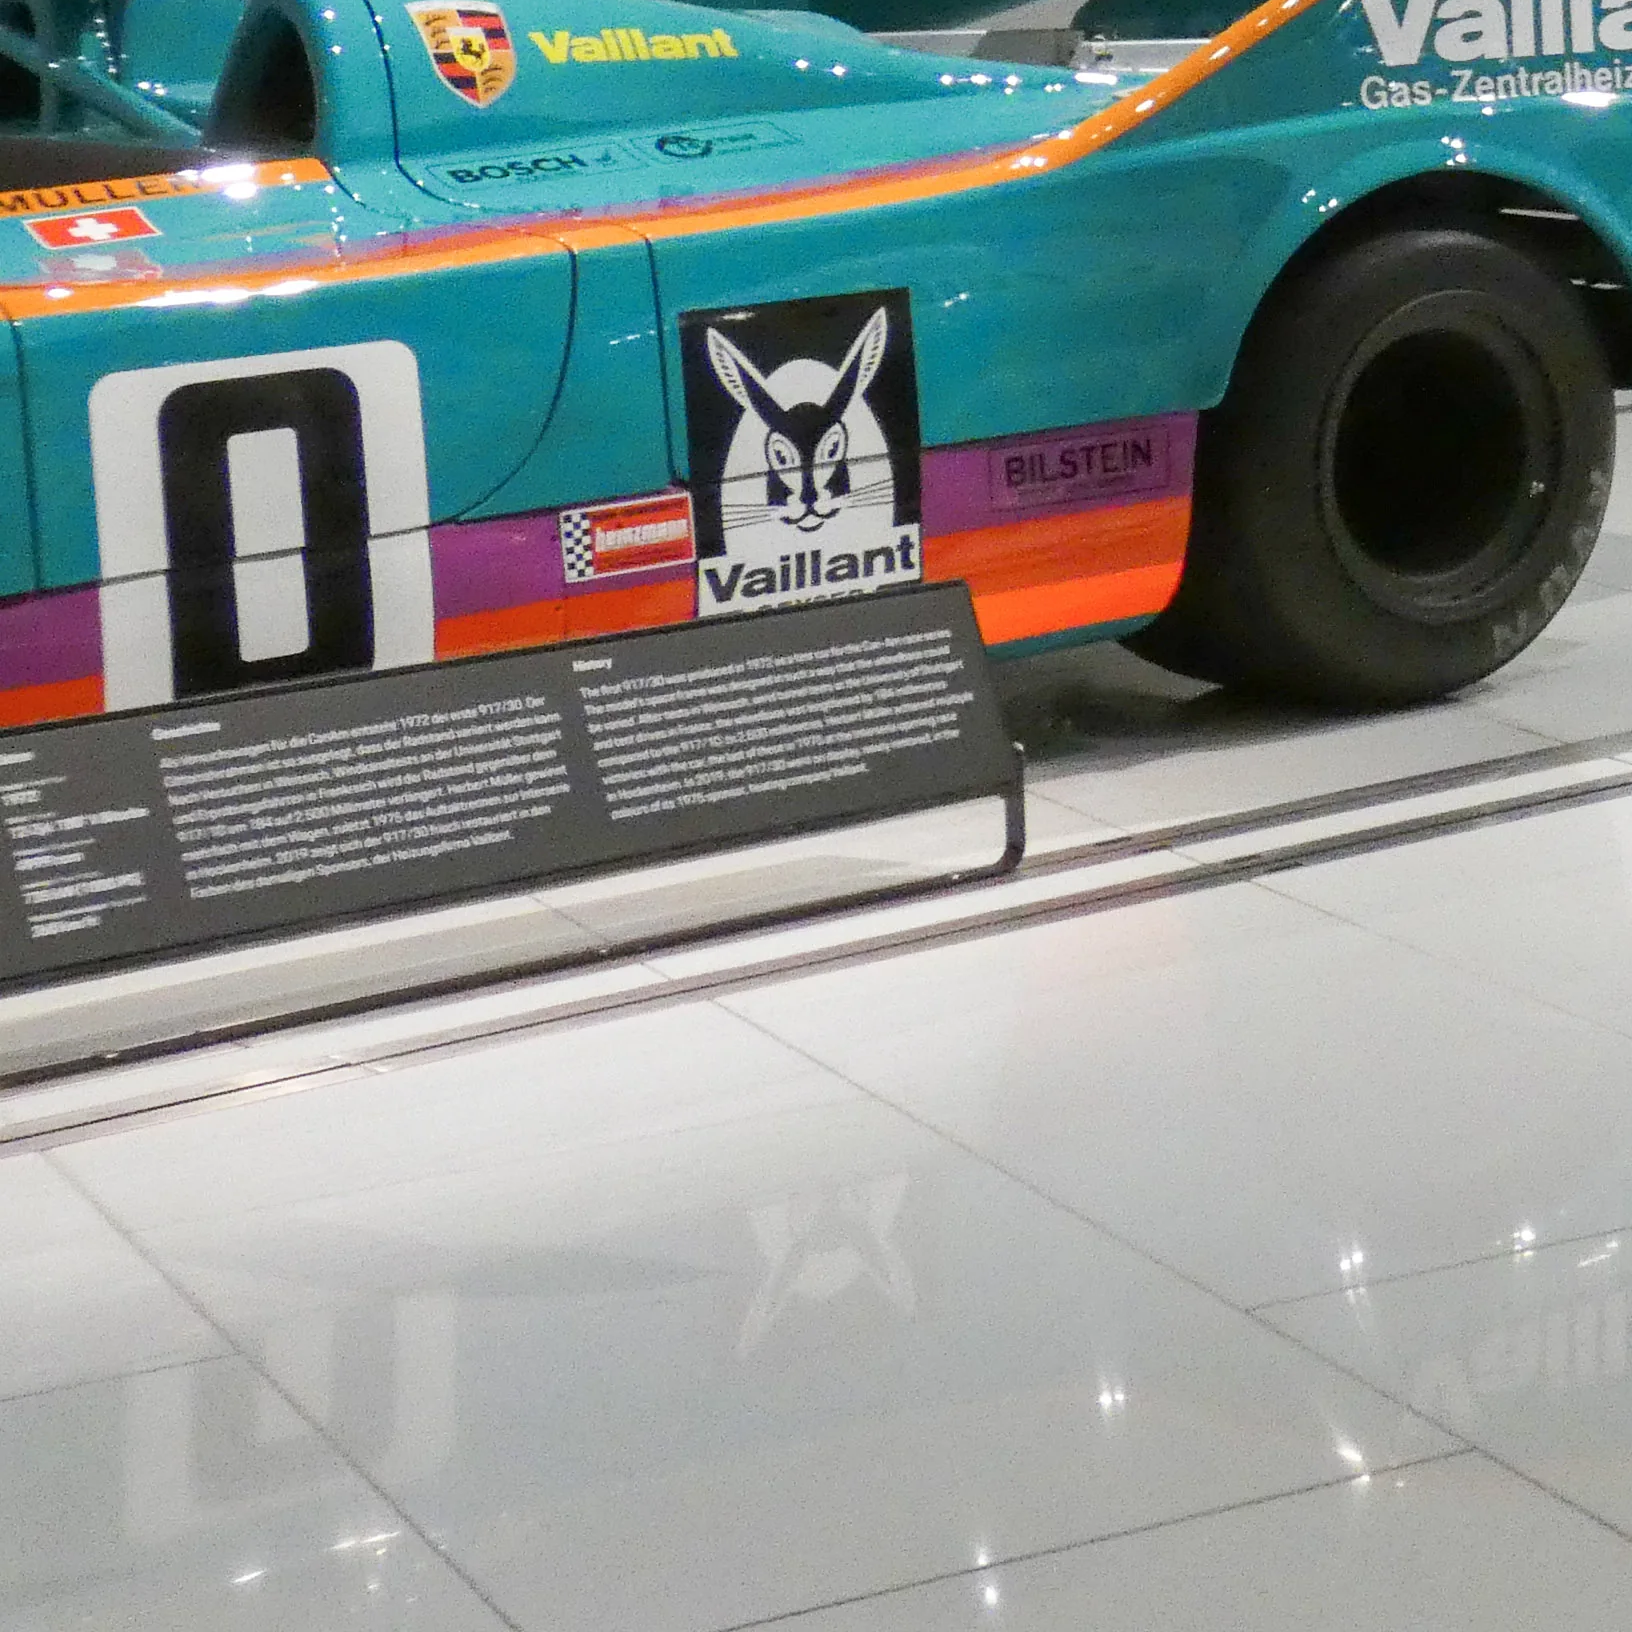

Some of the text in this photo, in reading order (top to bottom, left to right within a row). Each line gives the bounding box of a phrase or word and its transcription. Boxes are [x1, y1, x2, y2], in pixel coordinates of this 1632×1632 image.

[529, 27, 739, 65] Vaillant
[446, 153, 589, 184] BOSCH
[1004, 437, 1154, 489] BILSTEIN
[704, 534, 916, 604] Vaillant
